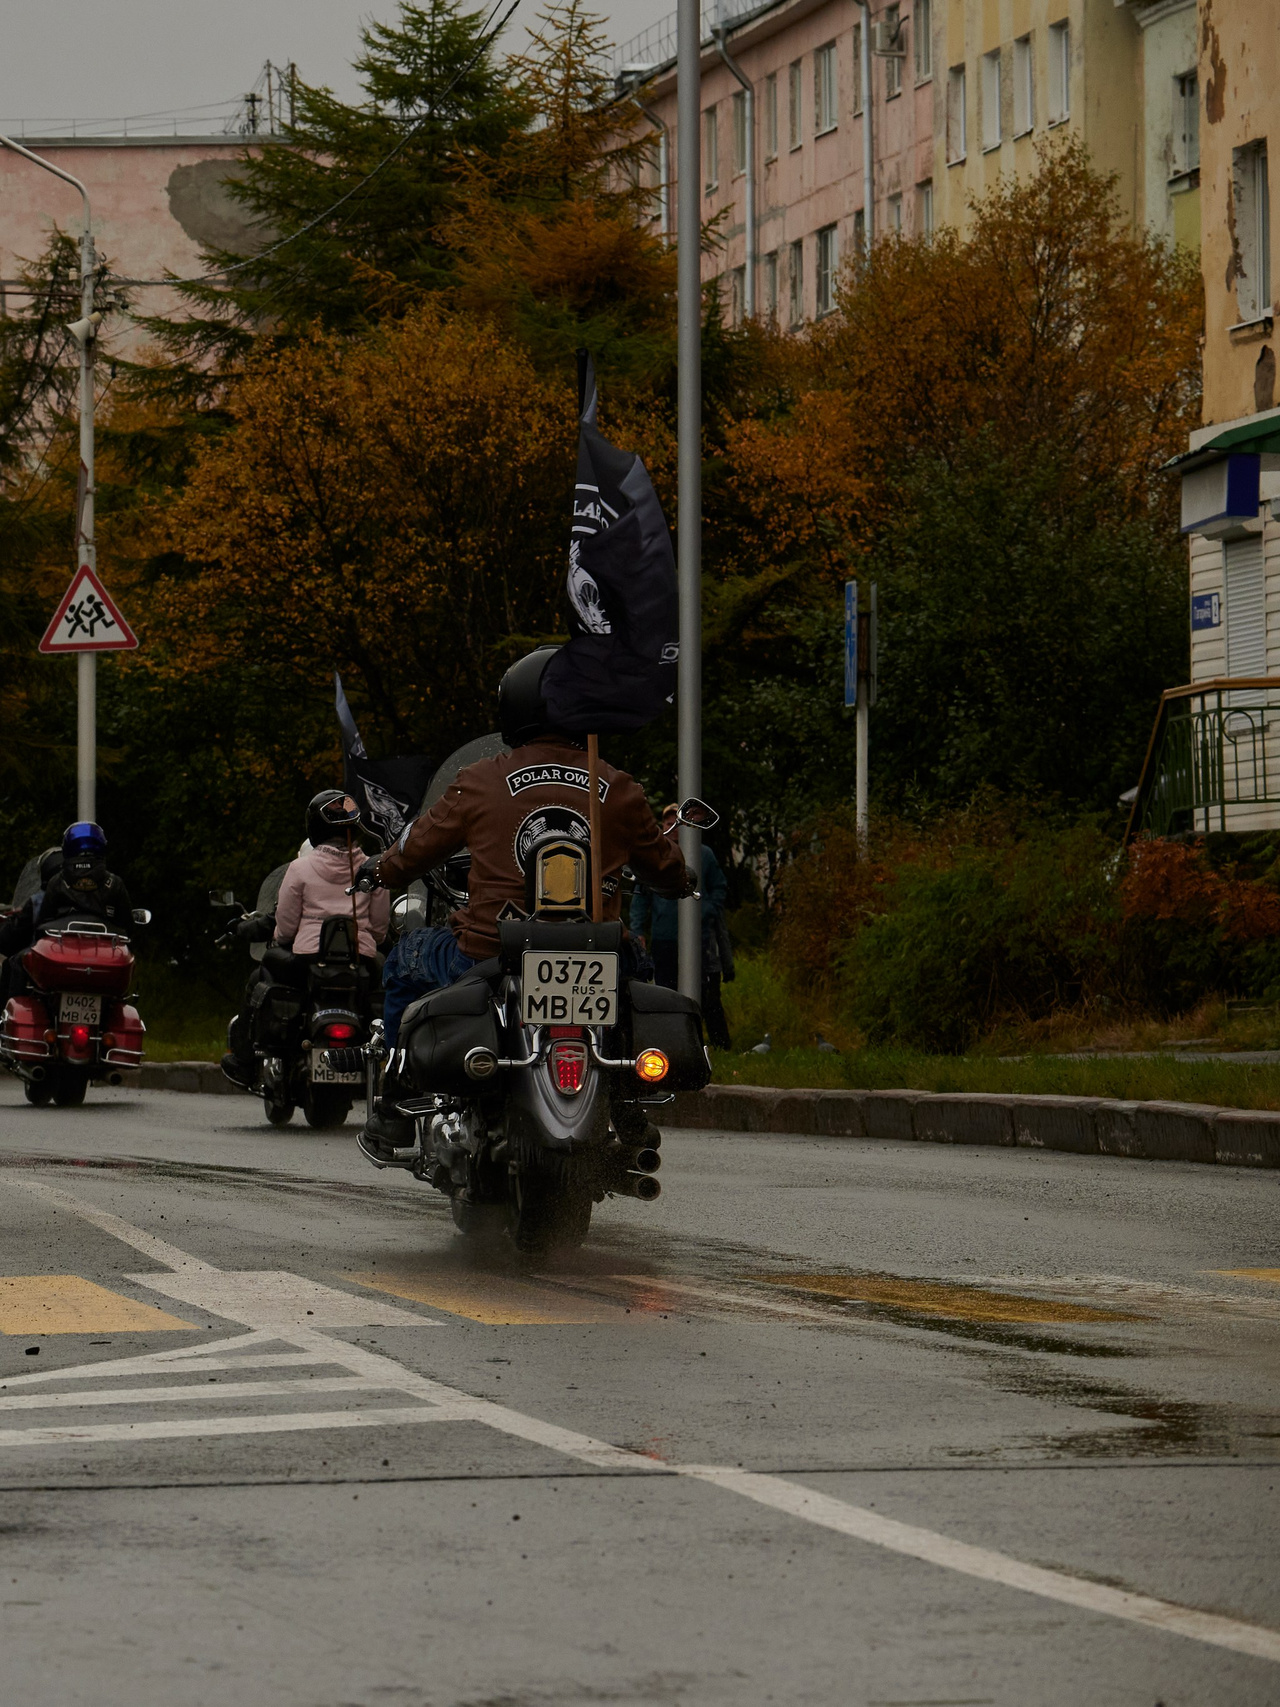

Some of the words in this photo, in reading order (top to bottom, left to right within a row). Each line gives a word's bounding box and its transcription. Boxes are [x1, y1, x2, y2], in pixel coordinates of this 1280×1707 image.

[511, 768, 562, 789] POLAR
[537, 960, 604, 985] 0372
[571, 986, 596, 995] RUS
[66, 995, 95, 1008] 0402
[527, 994, 568, 1019] MB
[578, 996, 611, 1020] 49
[60, 1010, 79, 1022] MB
[83, 1012, 98, 1023] 49
[314, 1068, 335, 1081] MB
